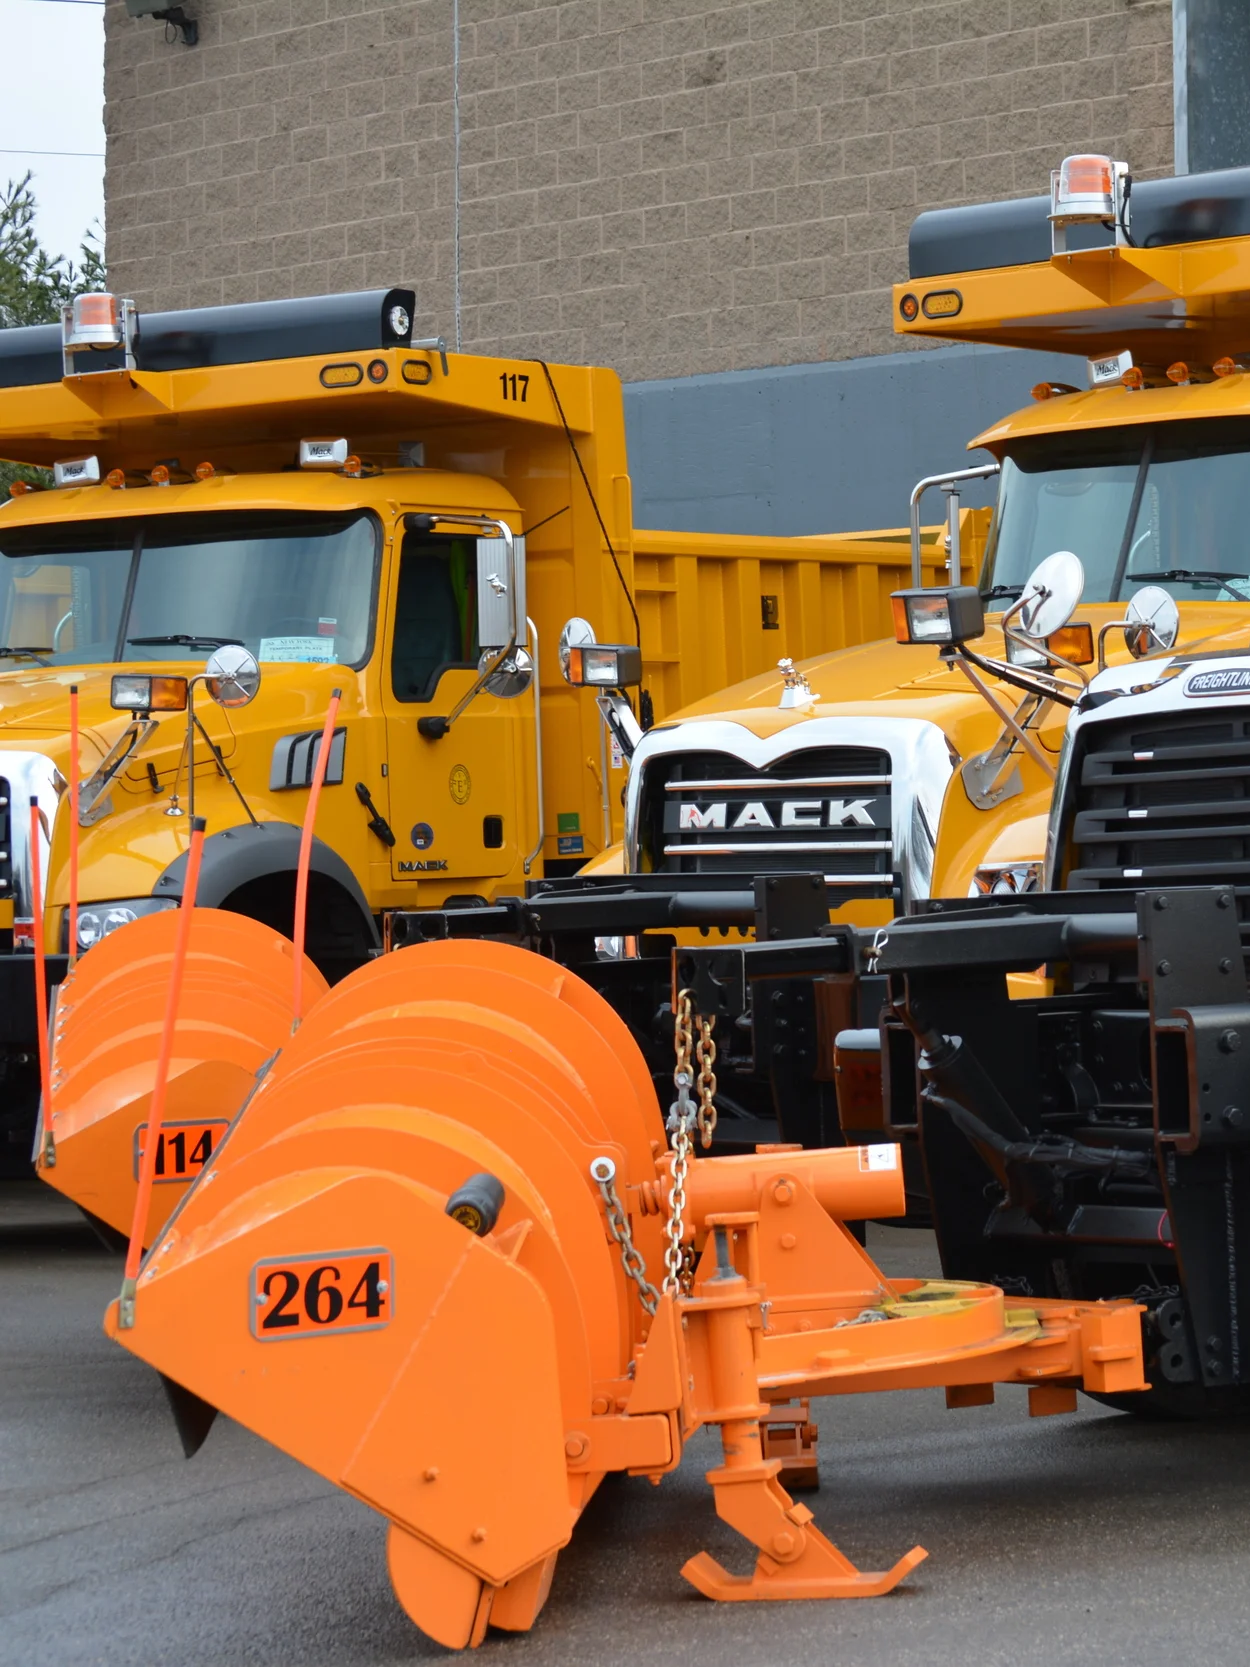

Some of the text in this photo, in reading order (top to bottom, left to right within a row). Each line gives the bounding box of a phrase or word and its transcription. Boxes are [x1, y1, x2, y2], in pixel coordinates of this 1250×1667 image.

[1097, 363, 1118, 376] Mack
[499, 372, 529, 402] 117
[310, 446, 332, 457] Mack
[64, 466, 84, 477] Mack
[679, 798, 877, 829] MACK
[262, 1262, 386, 1330] 264
